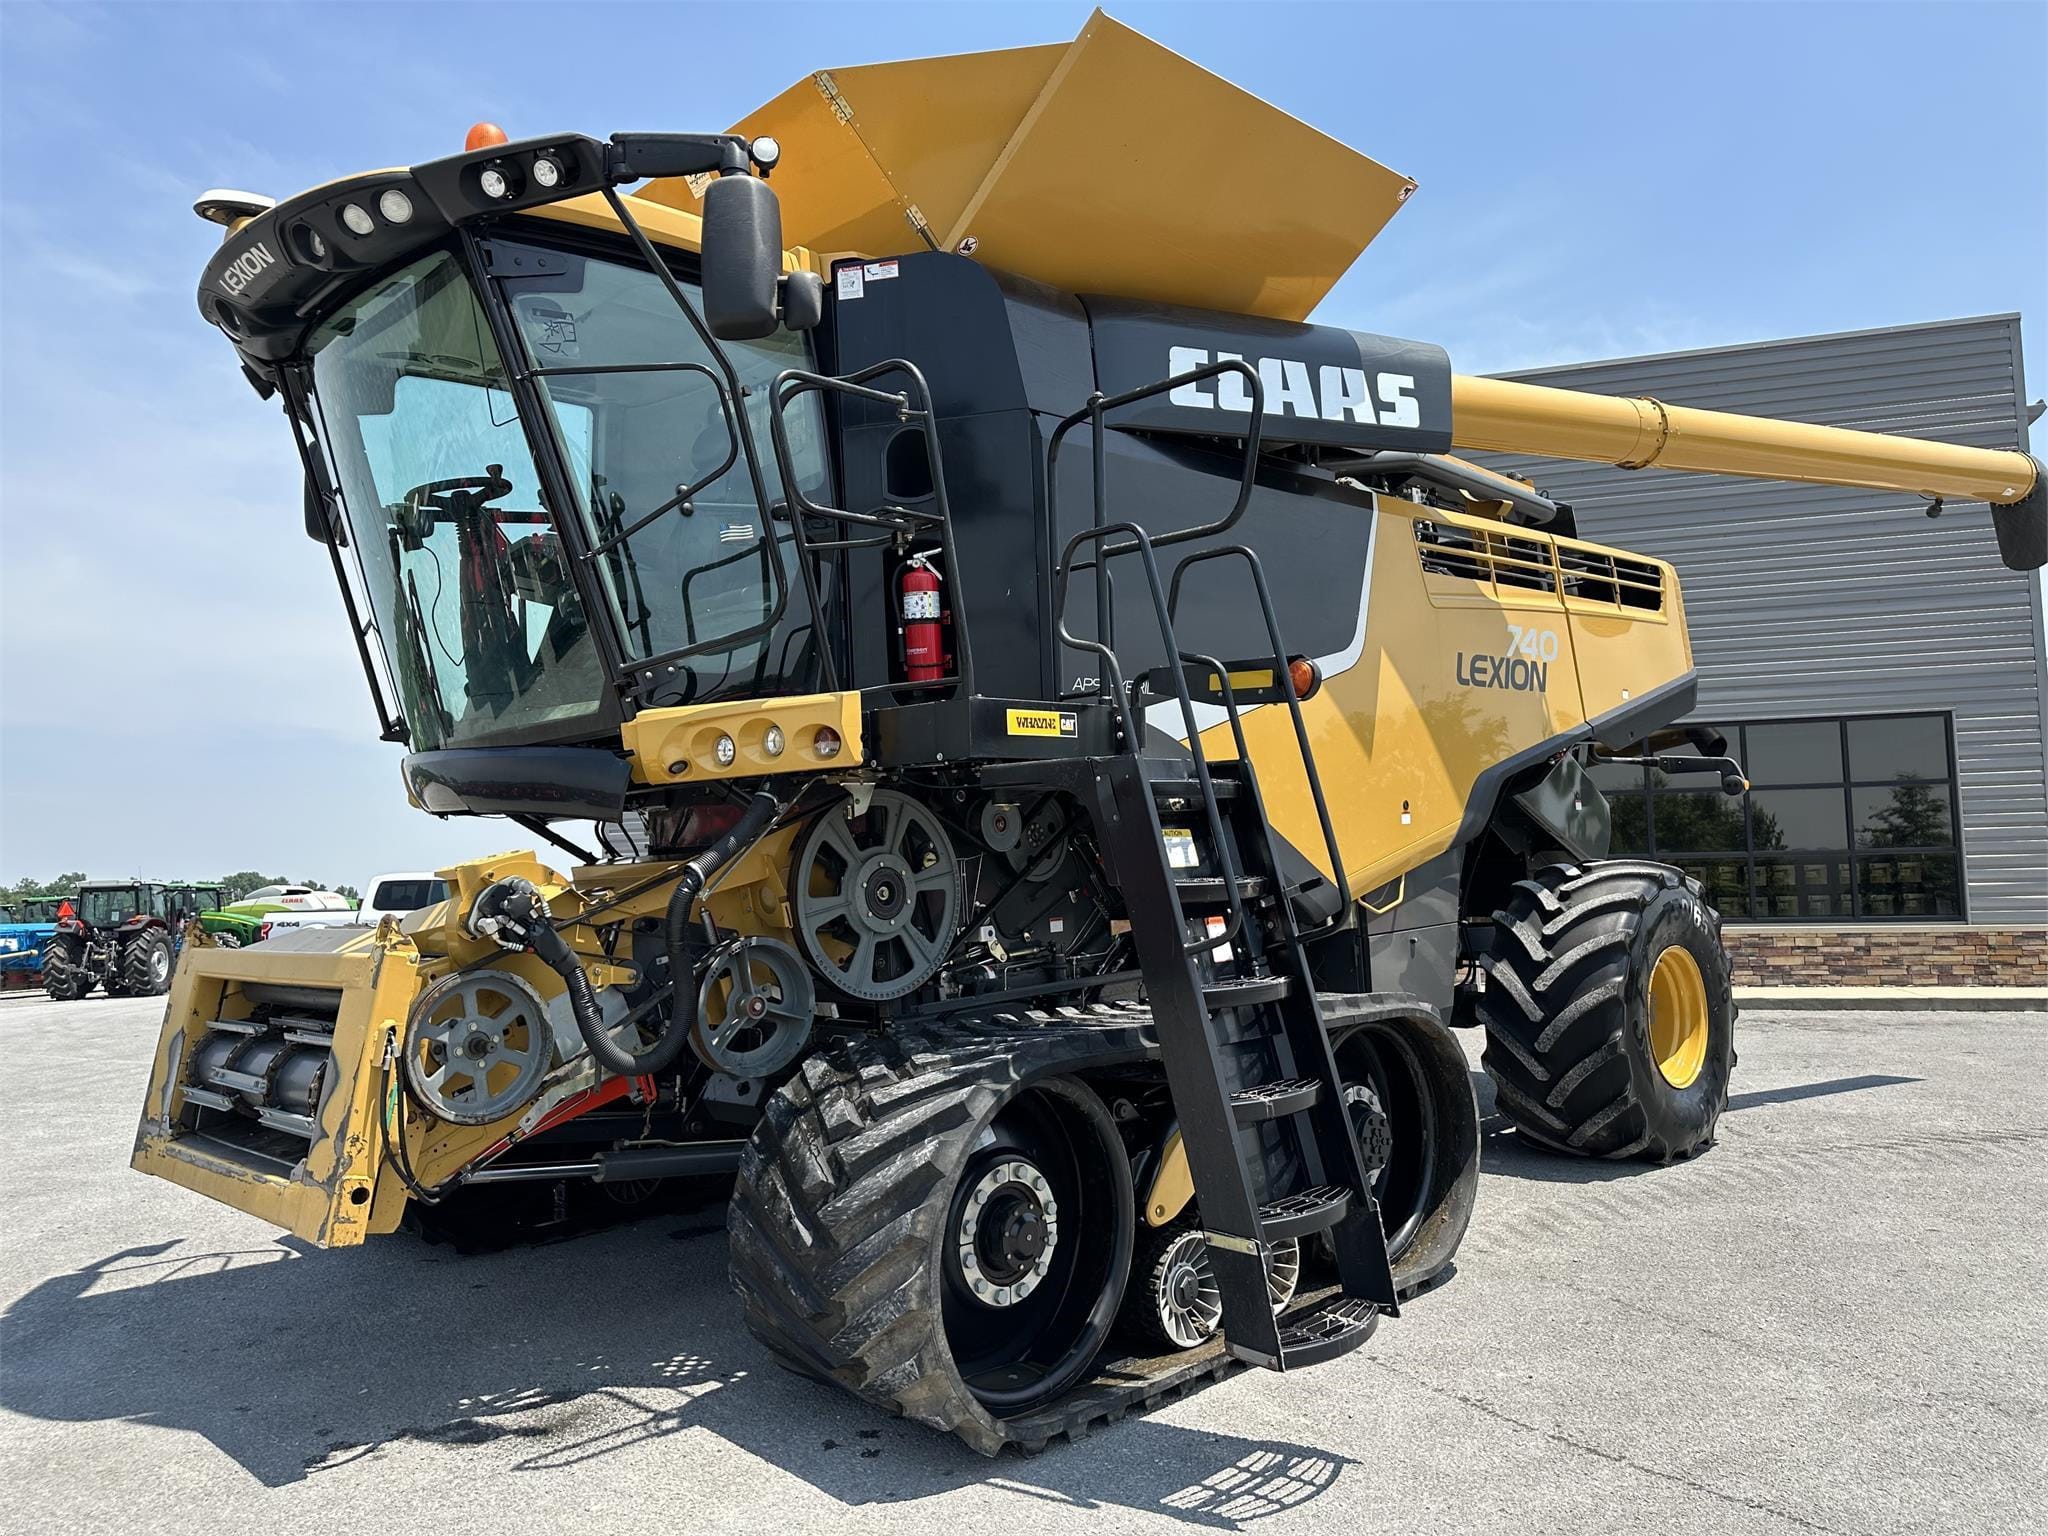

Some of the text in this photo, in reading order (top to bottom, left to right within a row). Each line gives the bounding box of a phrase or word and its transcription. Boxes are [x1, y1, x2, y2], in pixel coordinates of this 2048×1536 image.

[218, 242, 275, 296] LEXION
[1169, 345, 1421, 429] CLAAS
[1506, 624, 1559, 663] 740
[1456, 651, 1548, 693] LEXION
[1016, 716, 1075, 731] WHAYNE CAT
